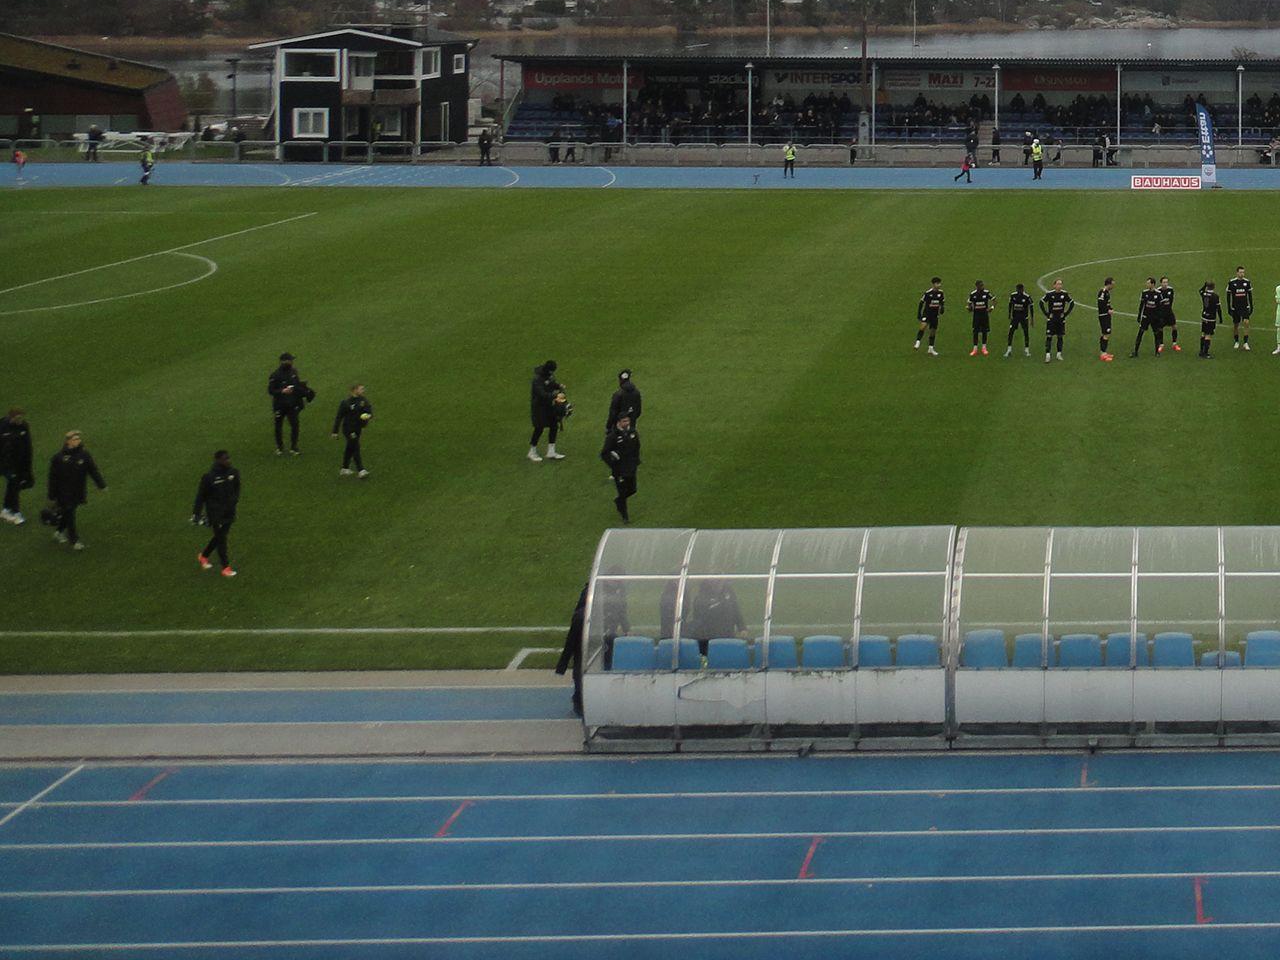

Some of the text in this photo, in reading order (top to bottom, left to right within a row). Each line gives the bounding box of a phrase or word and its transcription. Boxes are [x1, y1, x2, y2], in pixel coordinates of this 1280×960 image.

[534, 72, 593, 86] Upplands
[928, 72, 964, 85] MAXI
[1133, 177, 1200, 187] BAUHAUS
